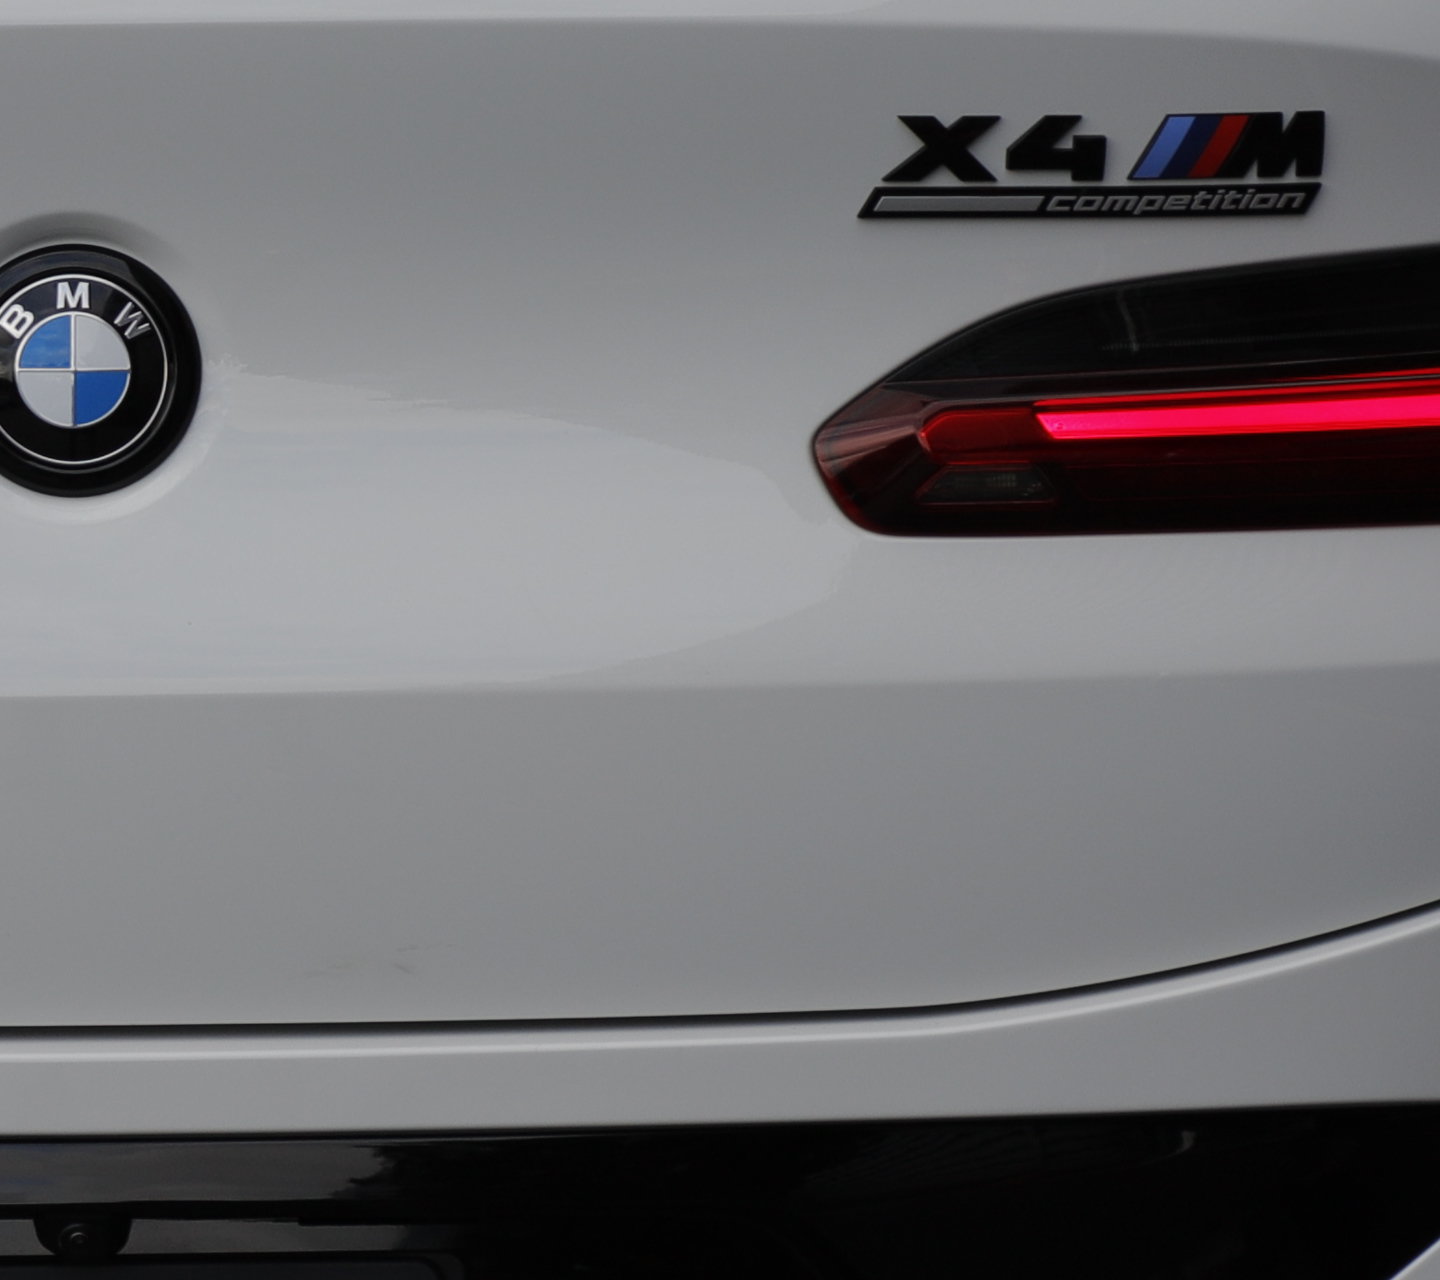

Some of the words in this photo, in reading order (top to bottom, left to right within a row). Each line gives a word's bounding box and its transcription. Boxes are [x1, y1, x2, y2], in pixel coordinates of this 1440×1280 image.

[881, 113, 1108, 182] X4
[1214, 110, 1326, 179] M
[1046, 188, 1305, 215] competition
